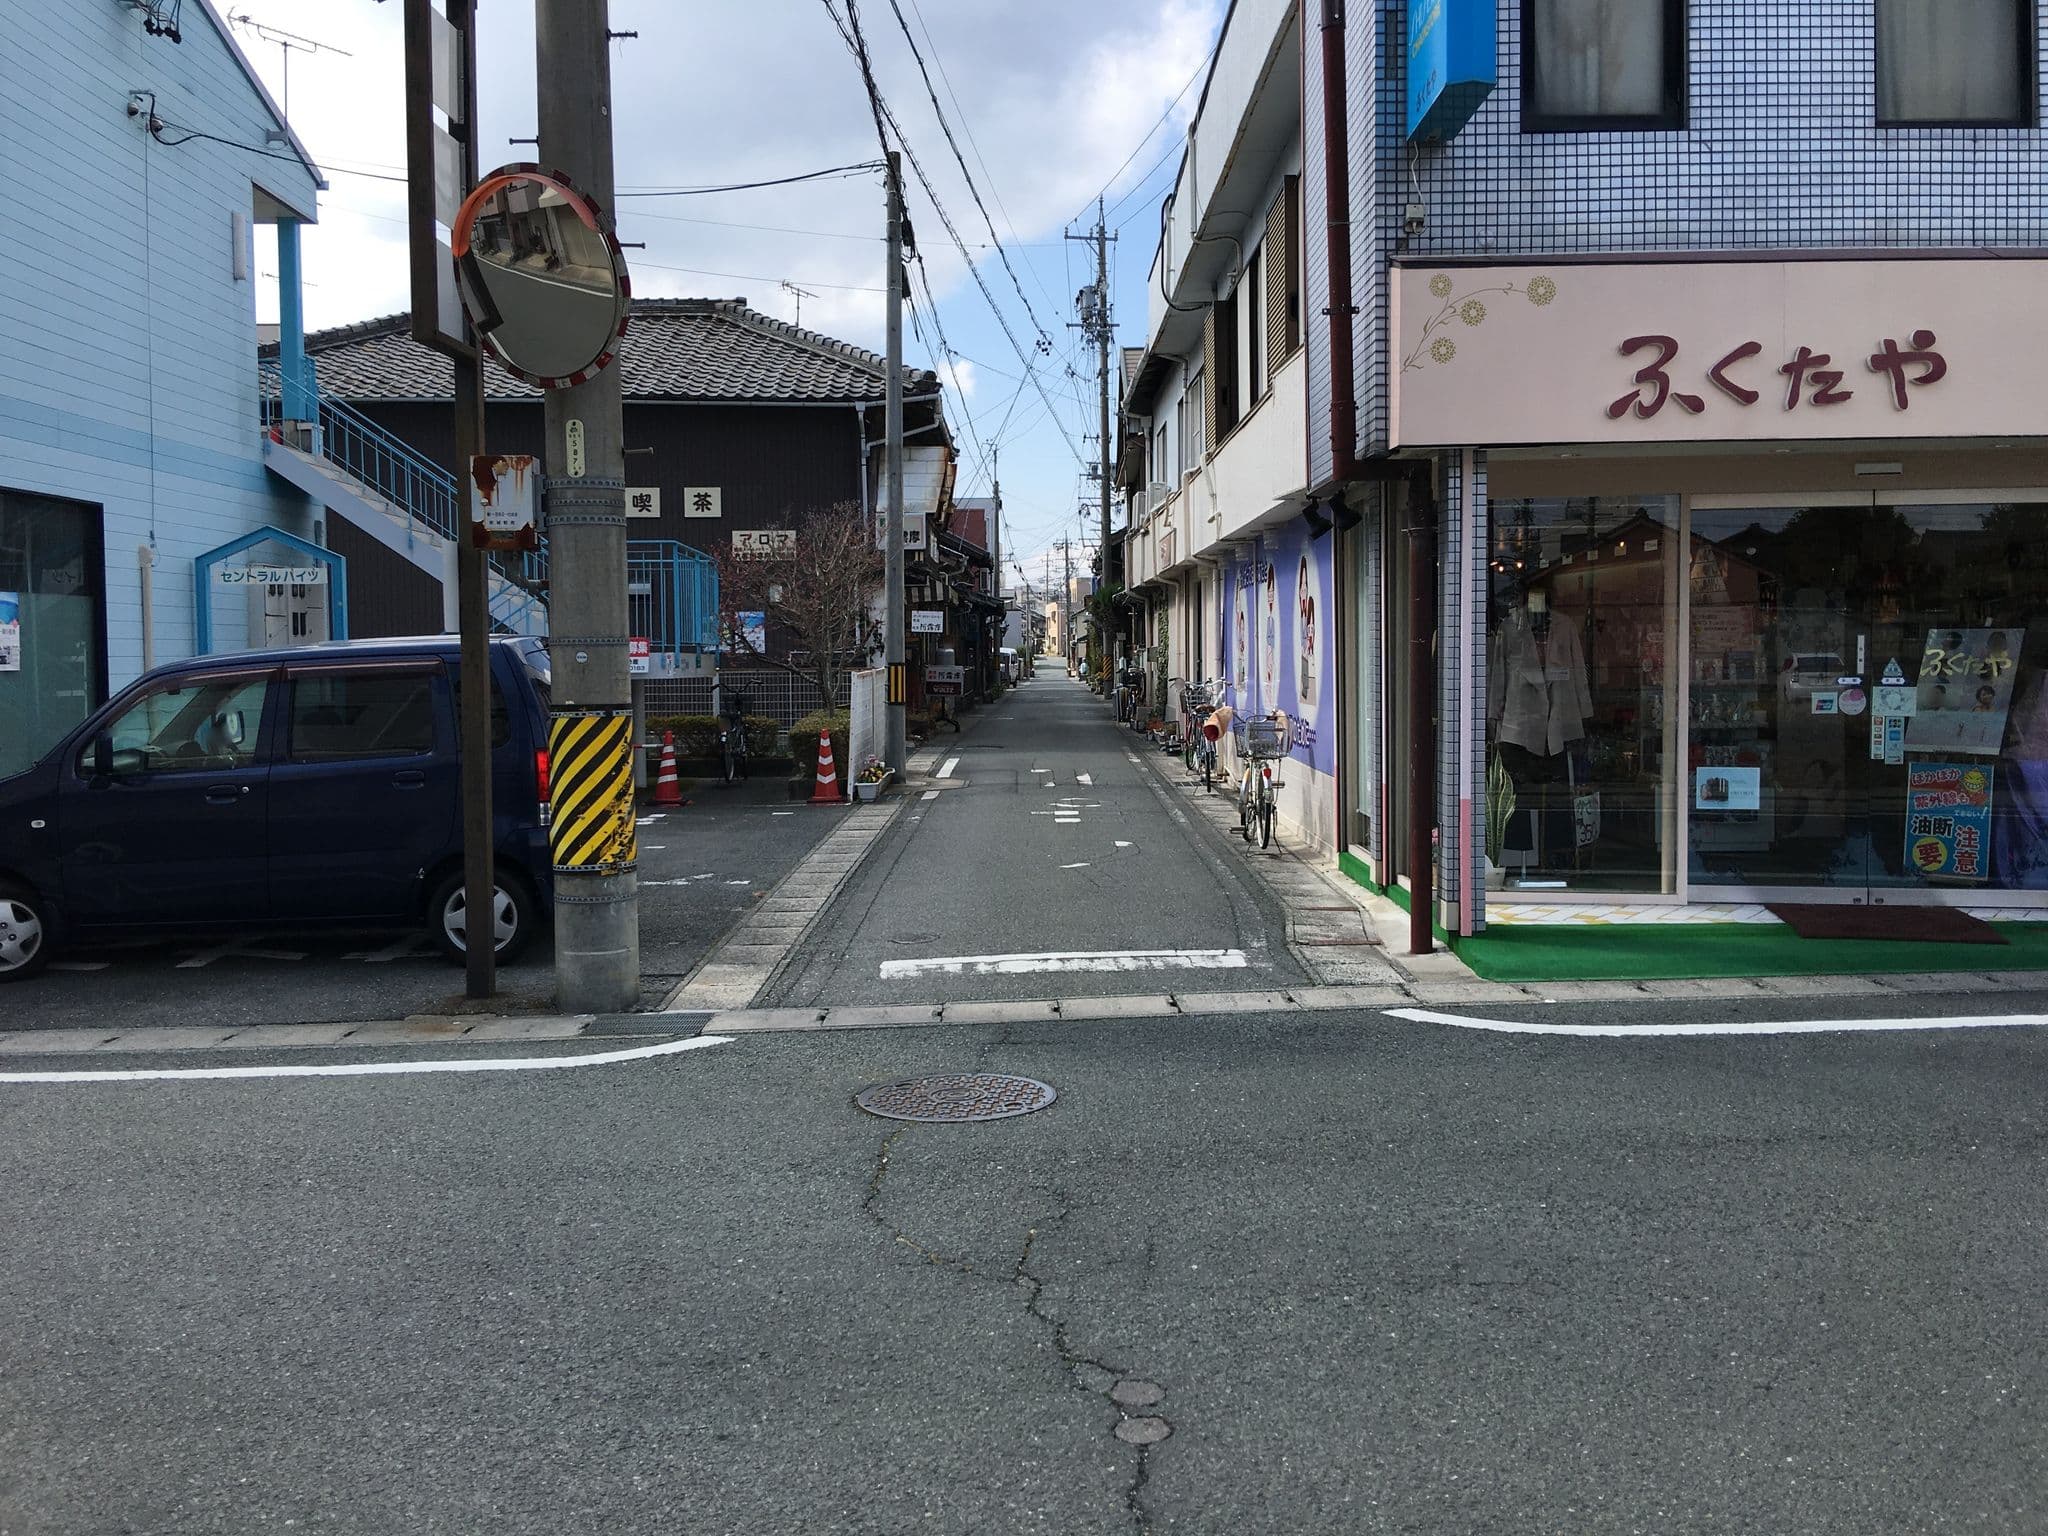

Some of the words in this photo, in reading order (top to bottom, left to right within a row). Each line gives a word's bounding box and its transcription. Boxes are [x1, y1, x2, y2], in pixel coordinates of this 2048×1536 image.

[1606, 328, 1948, 420] ふくたや
[632, 492, 652, 513] 喫
[692, 492, 713, 513] 茶
[221, 570, 319, 582] セントラルハイツ
[1920, 648, 2013, 679] ふくたや
[1911, 814, 1954, 838] 油断
[1916, 841, 1943, 867] 要
[1953, 824, 1981, 874] 注意
